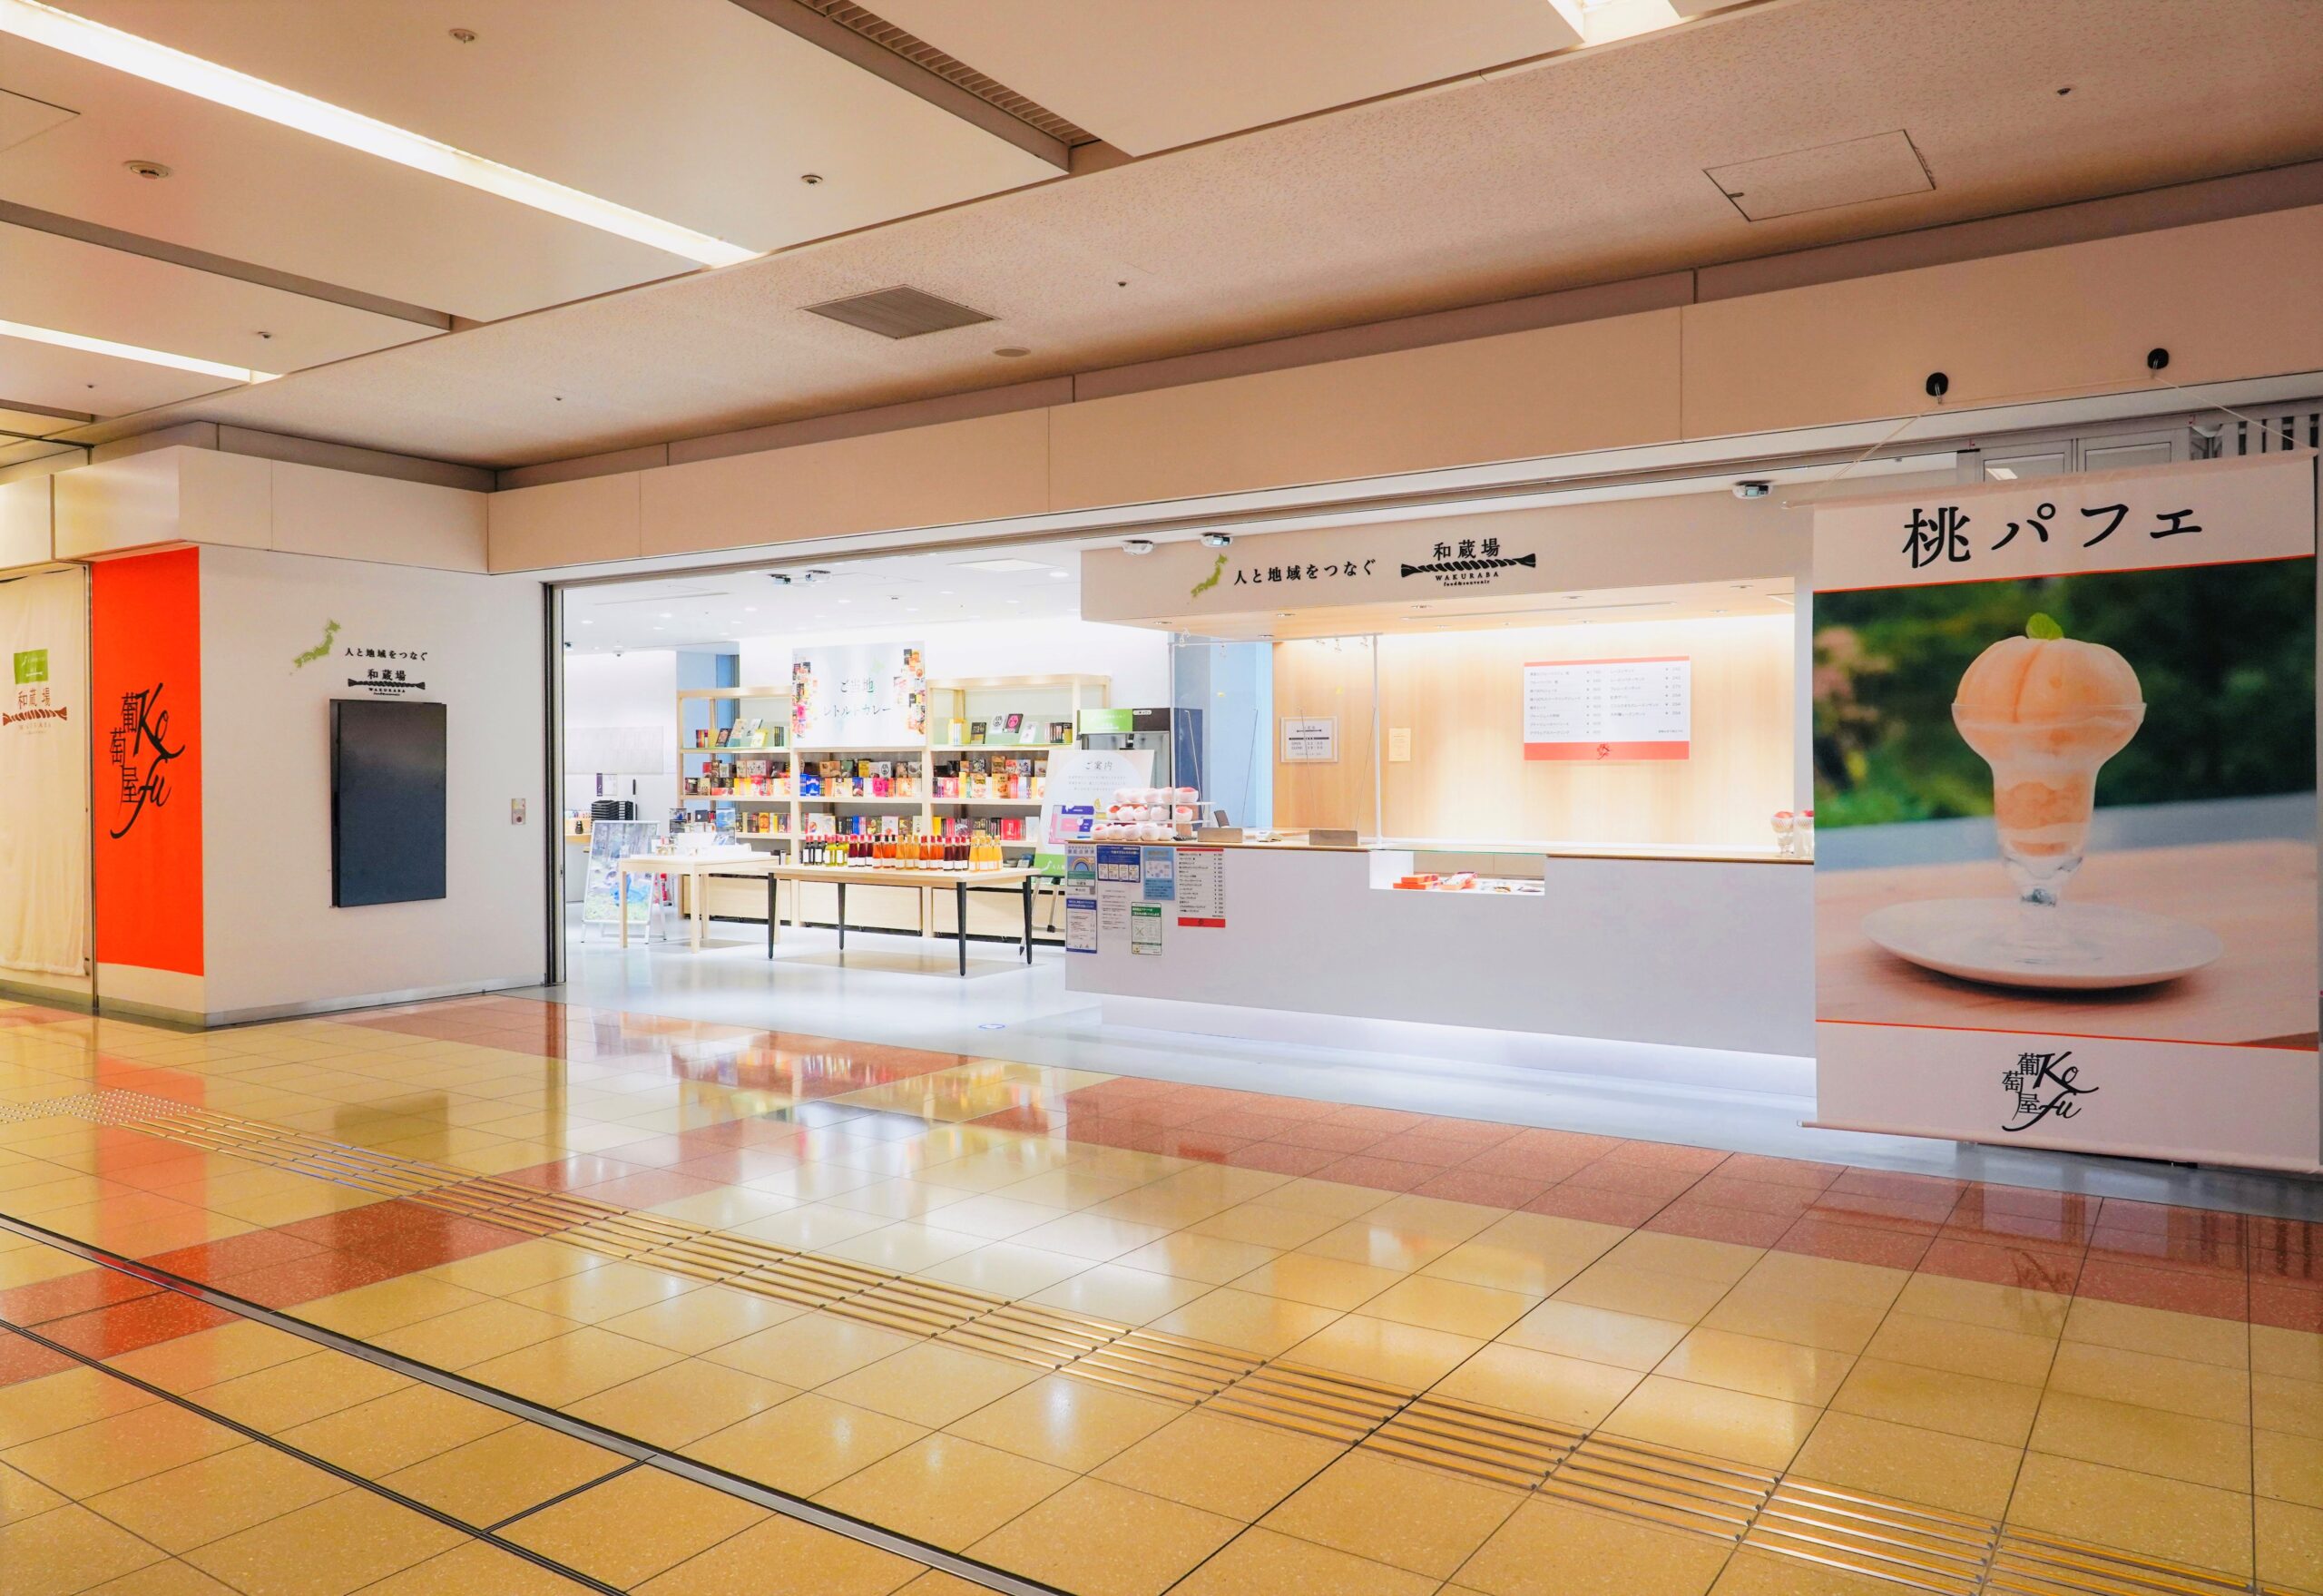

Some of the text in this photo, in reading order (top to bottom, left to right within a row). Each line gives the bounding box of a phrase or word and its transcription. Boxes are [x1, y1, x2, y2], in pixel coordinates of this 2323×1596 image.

[1902, 503, 2202, 569] 桃パフェ
[1433, 537, 1501, 561] 和蔵場
[1233, 559, 1376, 586] 人と地域をつなぐ
[1435, 571, 1499, 582] WAKURABA
[345, 647, 427, 661] 人と地域をつなぐ
[368, 668, 407, 681] 和蔵場
[2002, 1053, 2042, 1121] 葡萄屋
